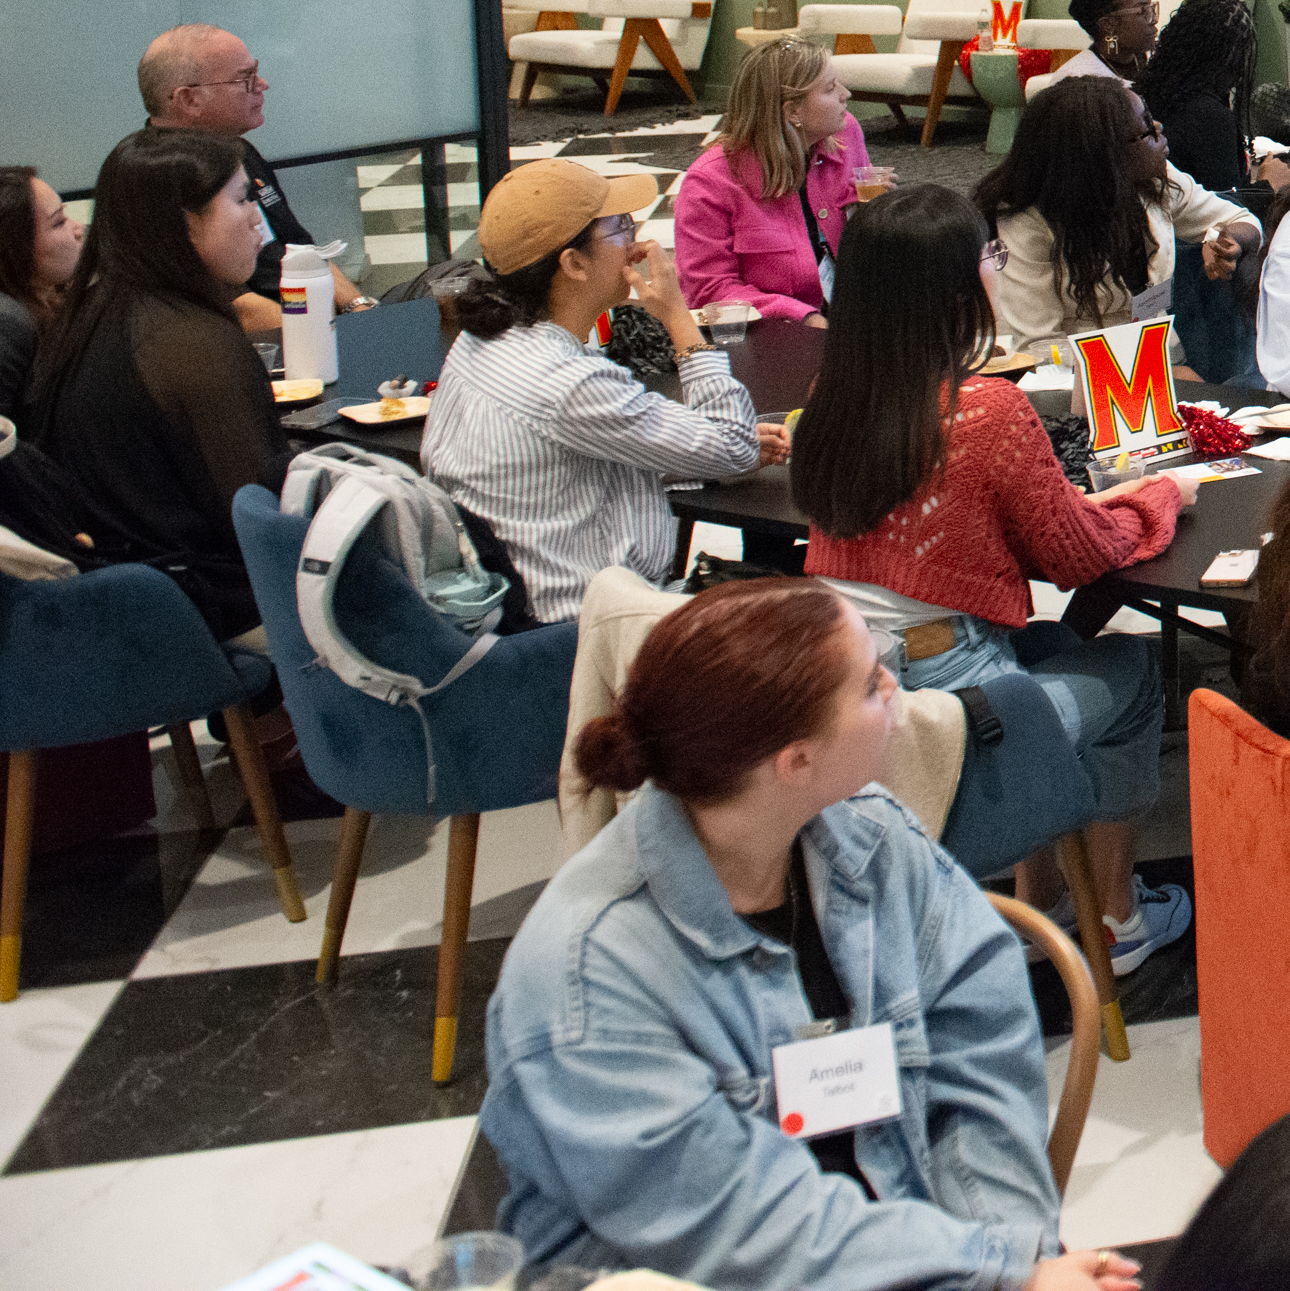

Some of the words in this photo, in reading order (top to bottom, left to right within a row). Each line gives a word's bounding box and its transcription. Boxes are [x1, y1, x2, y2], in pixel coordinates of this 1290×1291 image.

[990, 0, 1024, 43] M
[1074, 320, 1185, 452] M
[809, 1060, 864, 1082] Amelia
